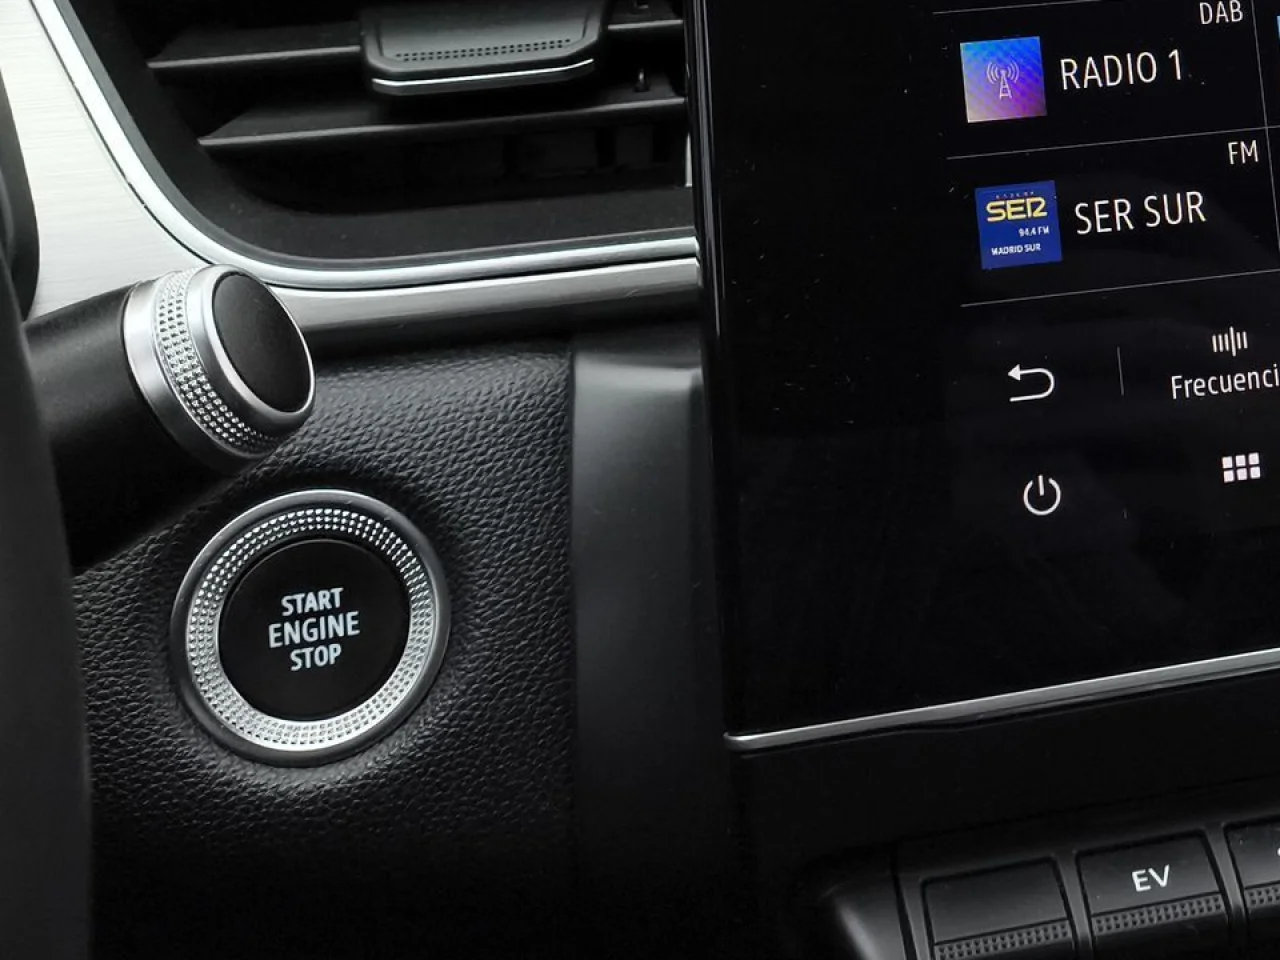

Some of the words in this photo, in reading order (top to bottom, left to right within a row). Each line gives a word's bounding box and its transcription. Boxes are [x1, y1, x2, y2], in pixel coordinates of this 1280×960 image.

[1199, 0, 1244, 25] DAB
[1060, 51, 1157, 90] RADIO
[1168, 49, 1181, 81] 1
[1227, 139, 1259, 165] FM
[986, 197, 1048, 222] SER
[1075, 198, 1135, 235] SER
[1143, 191, 1206, 228] SUR
[991, 245, 1023, 256] MADRID
[1024, 243, 1041, 252] SUR
[281, 587, 344, 616] START
[268, 611, 361, 648] ENGINE
[290, 643, 342, 672] STOP
[1131, 864, 1170, 892] EV
